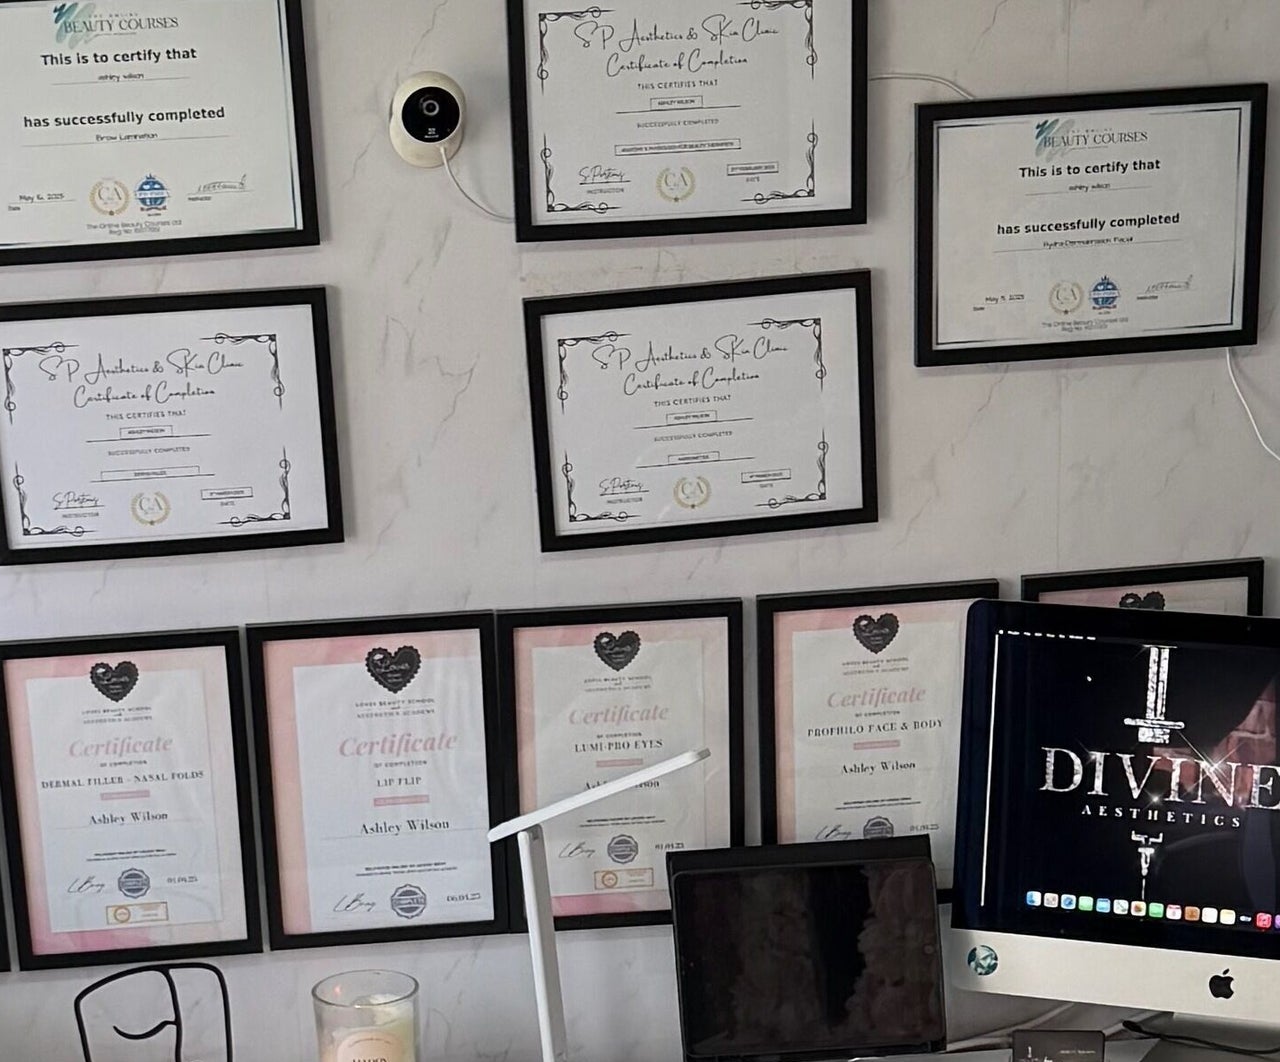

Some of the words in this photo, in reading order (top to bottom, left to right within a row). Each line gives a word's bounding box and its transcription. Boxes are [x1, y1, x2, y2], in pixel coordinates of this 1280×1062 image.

[63, 19, 114, 34] BEAUTY
[118, 17, 179, 31] COURSES
[619, 18, 683, 52] Aesthetics
[741, 17, 779, 41] Clinic
[40, 53, 71, 66] This
[77, 52, 89, 64] is
[93, 53, 109, 63] to
[113, 49, 161, 64] certify
[166, 48, 197, 60] that
[606, 52, 670, 77] Certificate
[673, 52, 684, 68] of
[687, 48, 748, 73] Completion
[657, 81, 696, 89] CERTIFIES
[699, 79, 718, 87] THAT
[23, 116, 50, 128] has
[54, 112, 144, 127] successfully
[148, 107, 225, 123] completed
[1043, 134, 1089, 148] BEAUTY
[1093, 131, 1148, 144] COURSES
[1019, 166, 1047, 178] This
[1051, 165, 1062, 176] is
[1067, 165, 1080, 175] to
[1084, 161, 1128, 174] certify
[1132, 159, 1161, 171] that
[996, 223, 1021, 235] has
[1024, 218, 1106, 234] successfully
[1110, 212, 1180, 228] completed
[635, 341, 698, 373] Aesthetics
[753, 336, 789, 360] Clinic
[84, 352, 150, 385] Aesthetics
[207, 352, 243, 376] Clinic
[624, 372, 685, 396] Certificate
[688, 372, 699, 388] of
[702, 365, 760, 390] Completion
[73, 385, 138, 408] Certificate
[141, 385, 152, 400] of
[154, 379, 215, 404] Completion
[672, 397, 711, 406] CERTIFIES
[126, 411, 166, 420] CERTIFIES
[827, 687, 927, 709] Certificate
[569, 704, 669, 726] Certificate
[807, 725, 865, 738] PROFHILO
[868, 722, 897, 733] FACE
[913, 719, 943, 730] BODY
[68, 736, 173, 758] Certificate
[338, 733, 458, 758] Certificate
[634, 739, 663, 749] EYES
[384, 759, 428, 767] COMPLETION
[840, 763, 877, 776] Ashley
[881, 761, 916, 772] Wilson
[41, 779, 85, 789] DERMAL
[87, 775, 124, 787] FILLER
[133, 772, 168, 783] NASAL
[171, 770, 204, 780] FOLDS
[377, 778, 395, 788] LIP
[397, 776, 422, 786] FLIP
[88, 815, 126, 827] Ashley
[131, 811, 168, 822] Wilson
[1081, 804, 1242, 829] AESTHETICS
[360, 823, 403, 836] Ashley
[407, 819, 450, 831] Wilson
